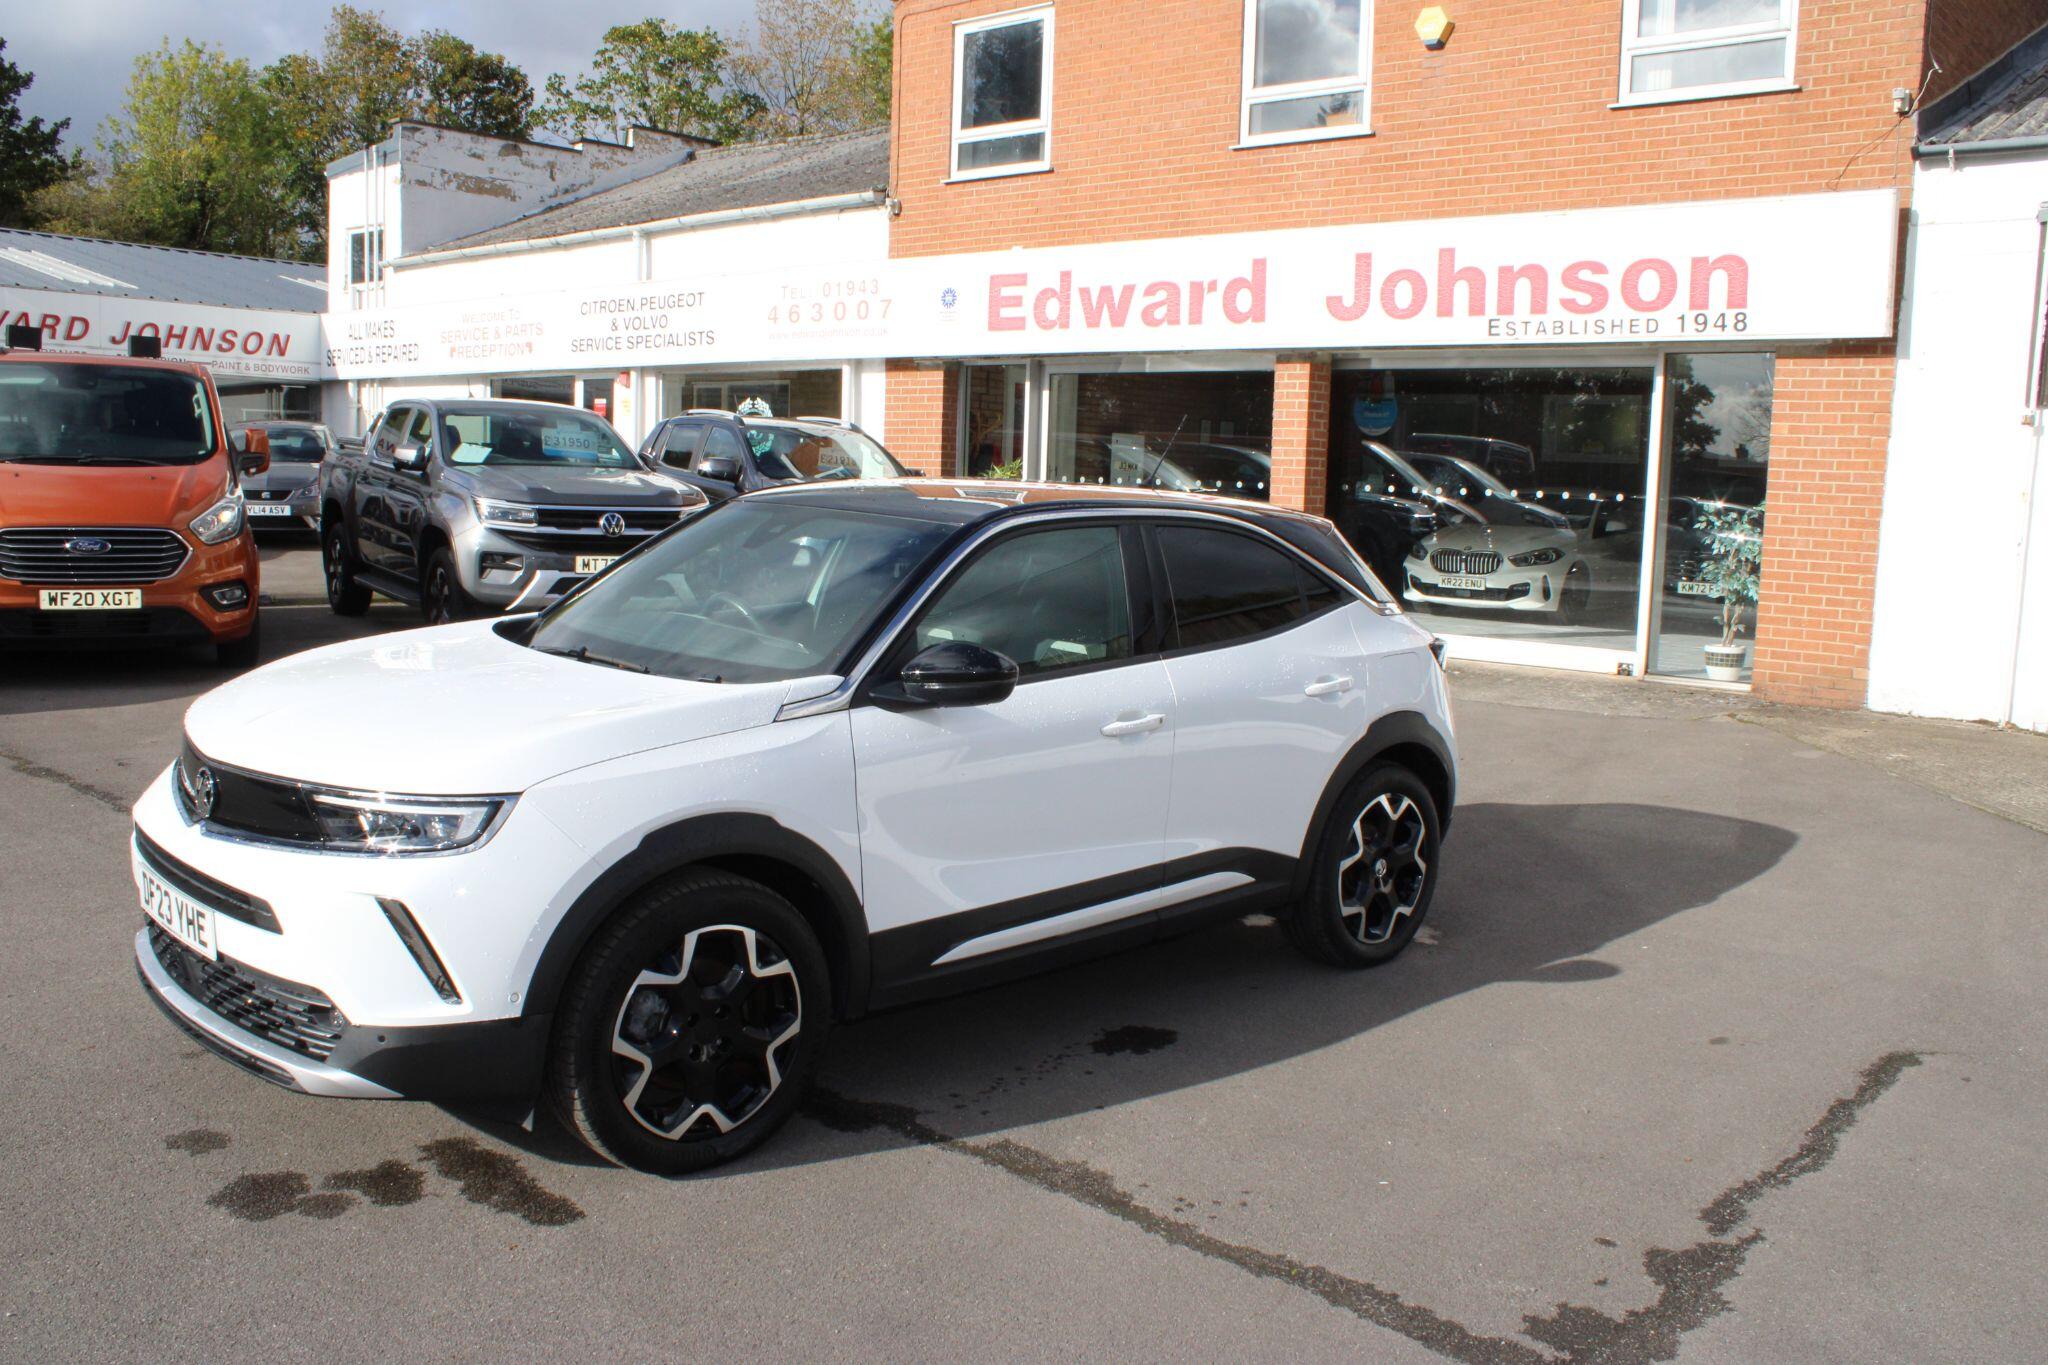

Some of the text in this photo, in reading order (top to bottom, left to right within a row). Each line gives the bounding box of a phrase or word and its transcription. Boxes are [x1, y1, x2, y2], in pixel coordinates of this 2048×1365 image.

[822, 278, 879, 297] 01943
[988, 247, 1749, 331] Edward Johnson
[768, 299, 892, 324] 463007
[348, 320, 395, 340] ALL MAKES
[440, 322, 544, 344] SERVICE & PARTS
[610, 314, 668, 332] & VOLVO
[1487, 312, 1749, 337] ESTABLISHED 1948
[0, 310, 291, 357] ARD JOHNSON
[571, 330, 715, 353] SERVICE SPECIALISTS
[327, 343, 419, 367] SERVICED & REPAIRED
[211, 360, 310, 375] PAINT & BODYWORK
[543, 434, 590, 448] £31950
[247, 506, 285, 514] YL14 ASV
[1441, 577, 1482, 588] KR22 ENU
[1681, 583, 1706, 593] KM72
[48, 591, 134, 606] WF20 XGT
[142, 871, 208, 949] DF23 YHE
